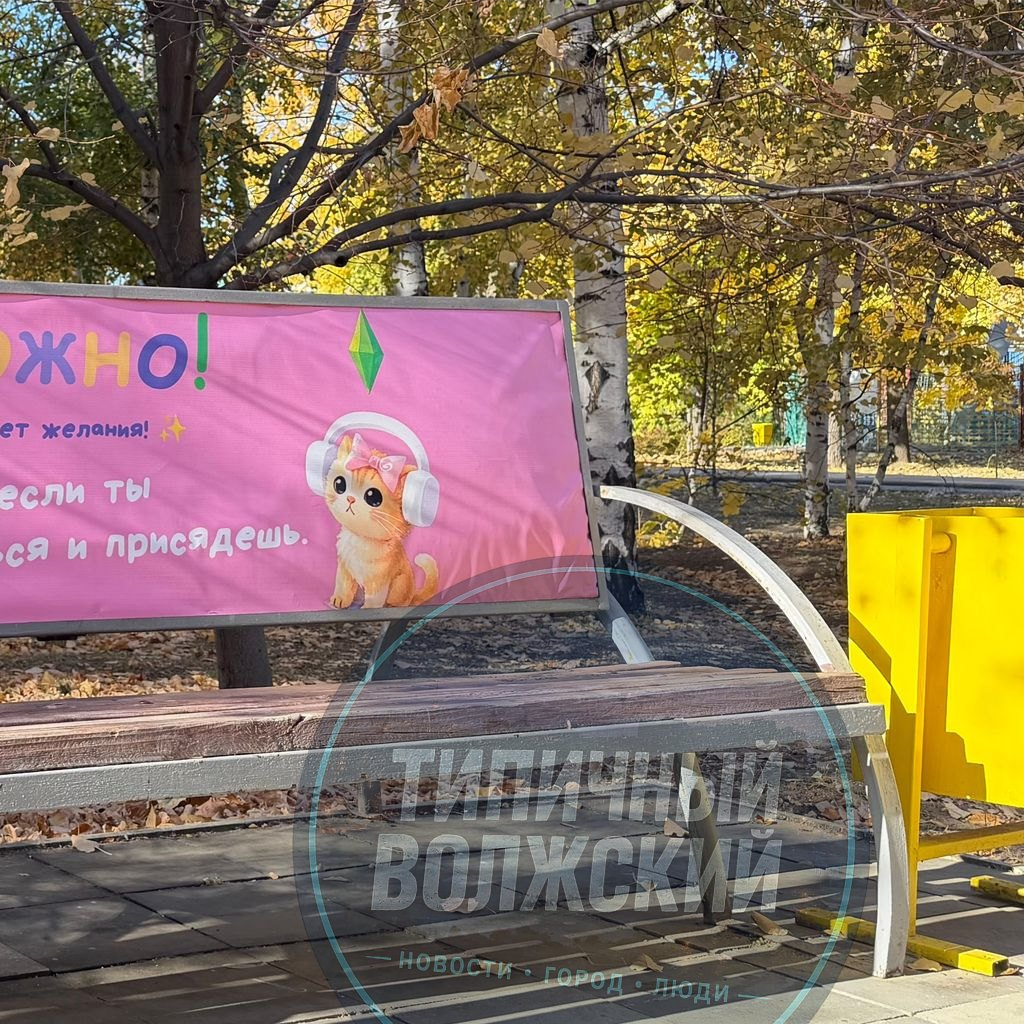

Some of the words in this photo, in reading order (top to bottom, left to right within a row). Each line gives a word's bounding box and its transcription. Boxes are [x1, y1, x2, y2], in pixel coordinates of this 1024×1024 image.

[42, 422, 150, 439] желания!
[104, 478, 152, 505] ты
[67, 539, 88, 562] и
[106, 522, 310, 566] присядешь.
